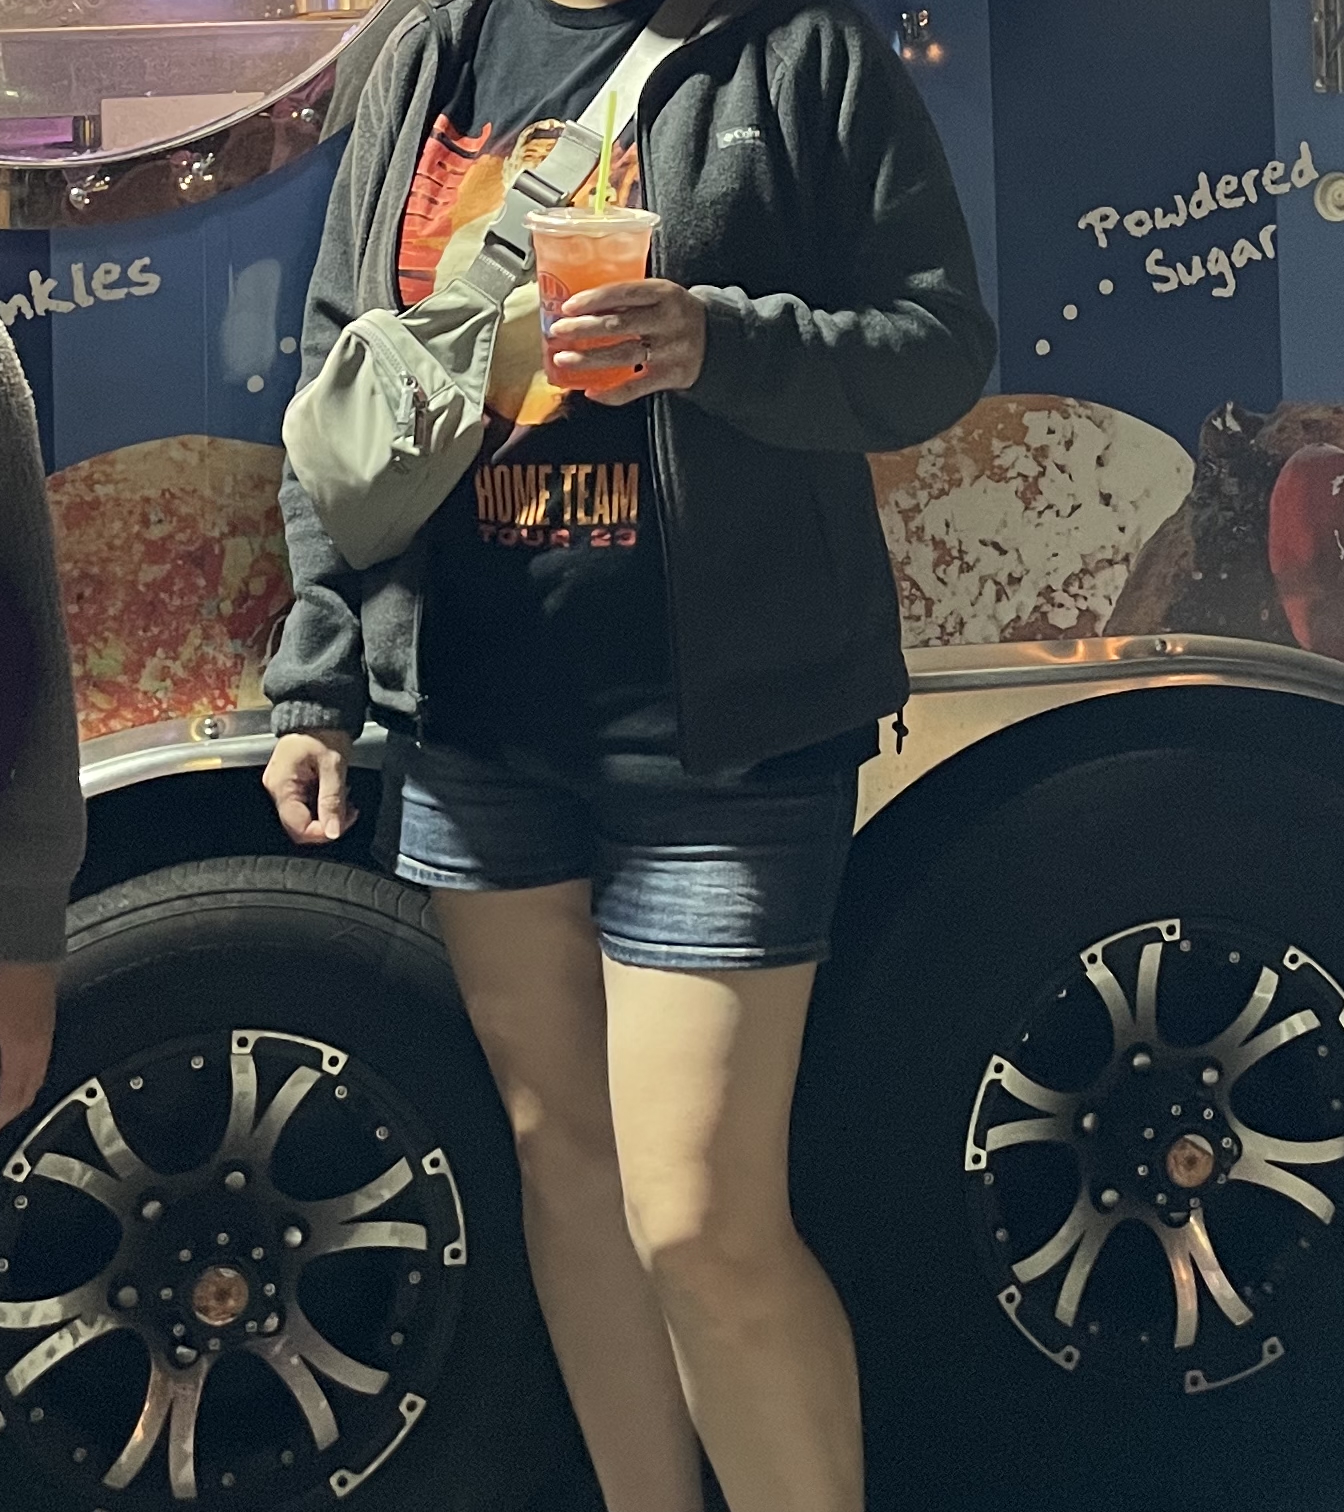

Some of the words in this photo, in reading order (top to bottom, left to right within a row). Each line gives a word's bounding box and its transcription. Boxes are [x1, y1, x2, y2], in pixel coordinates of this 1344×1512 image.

[1077, 141, 1320, 248] Powdered
[1145, 224, 1278, 298] Sugar
[474, 463, 553, 527] HOME
[560, 462, 640, 526] TEAM
[478, 524, 571, 549] TOUR
